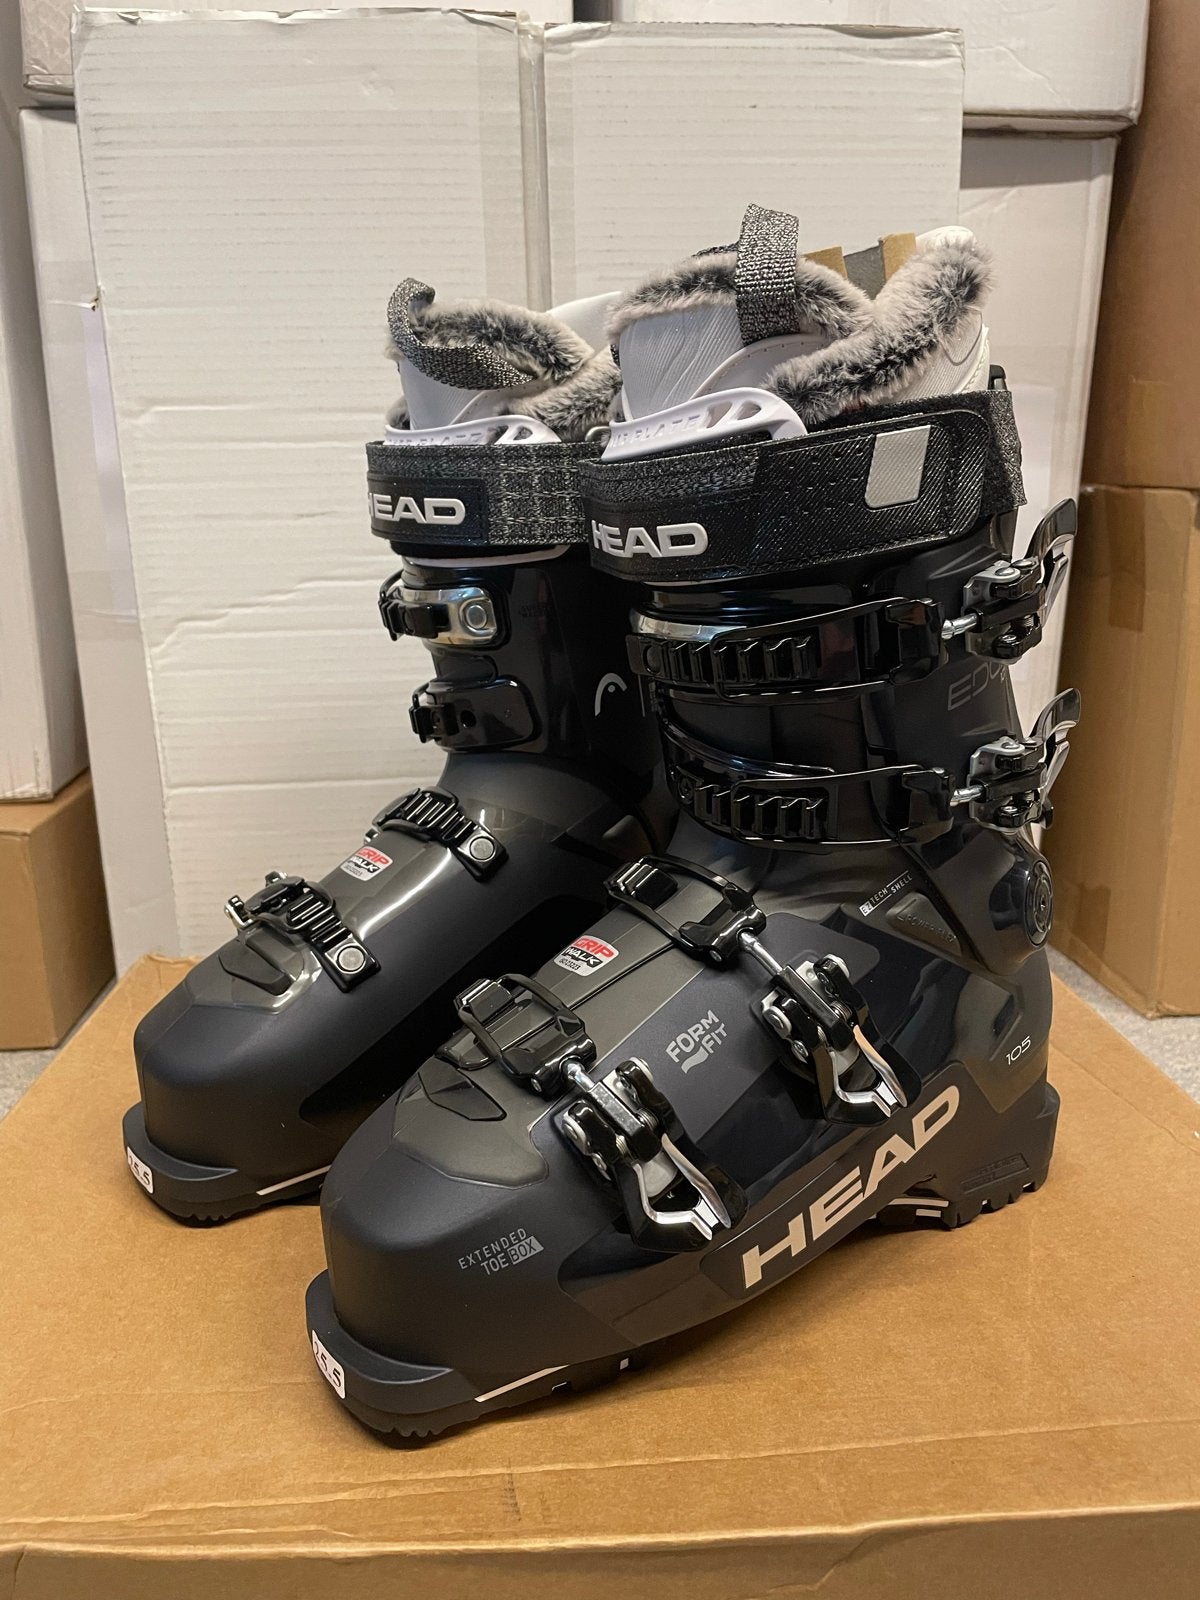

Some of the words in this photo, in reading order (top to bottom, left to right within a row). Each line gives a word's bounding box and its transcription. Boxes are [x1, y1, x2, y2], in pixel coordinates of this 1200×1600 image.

[369, 493, 466, 525] EAD
[592, 520, 708, 558] HEAD
[869, 886, 889, 905] TECH
[890, 874, 913, 894] SHELL
[563, 946, 602, 966] WALK
[574, 938, 615, 958] GRIP
[665, 1009, 720, 1063] FORM
[701, 1022, 728, 1054] FIT
[1005, 1035, 1032, 1065] 105
[742, 1085, 960, 1289] HEAD
[458, 1228, 527, 1270] EXTENDED
[480, 1252, 510, 1276] TOE
[508, 1238, 537, 1263] BOX
